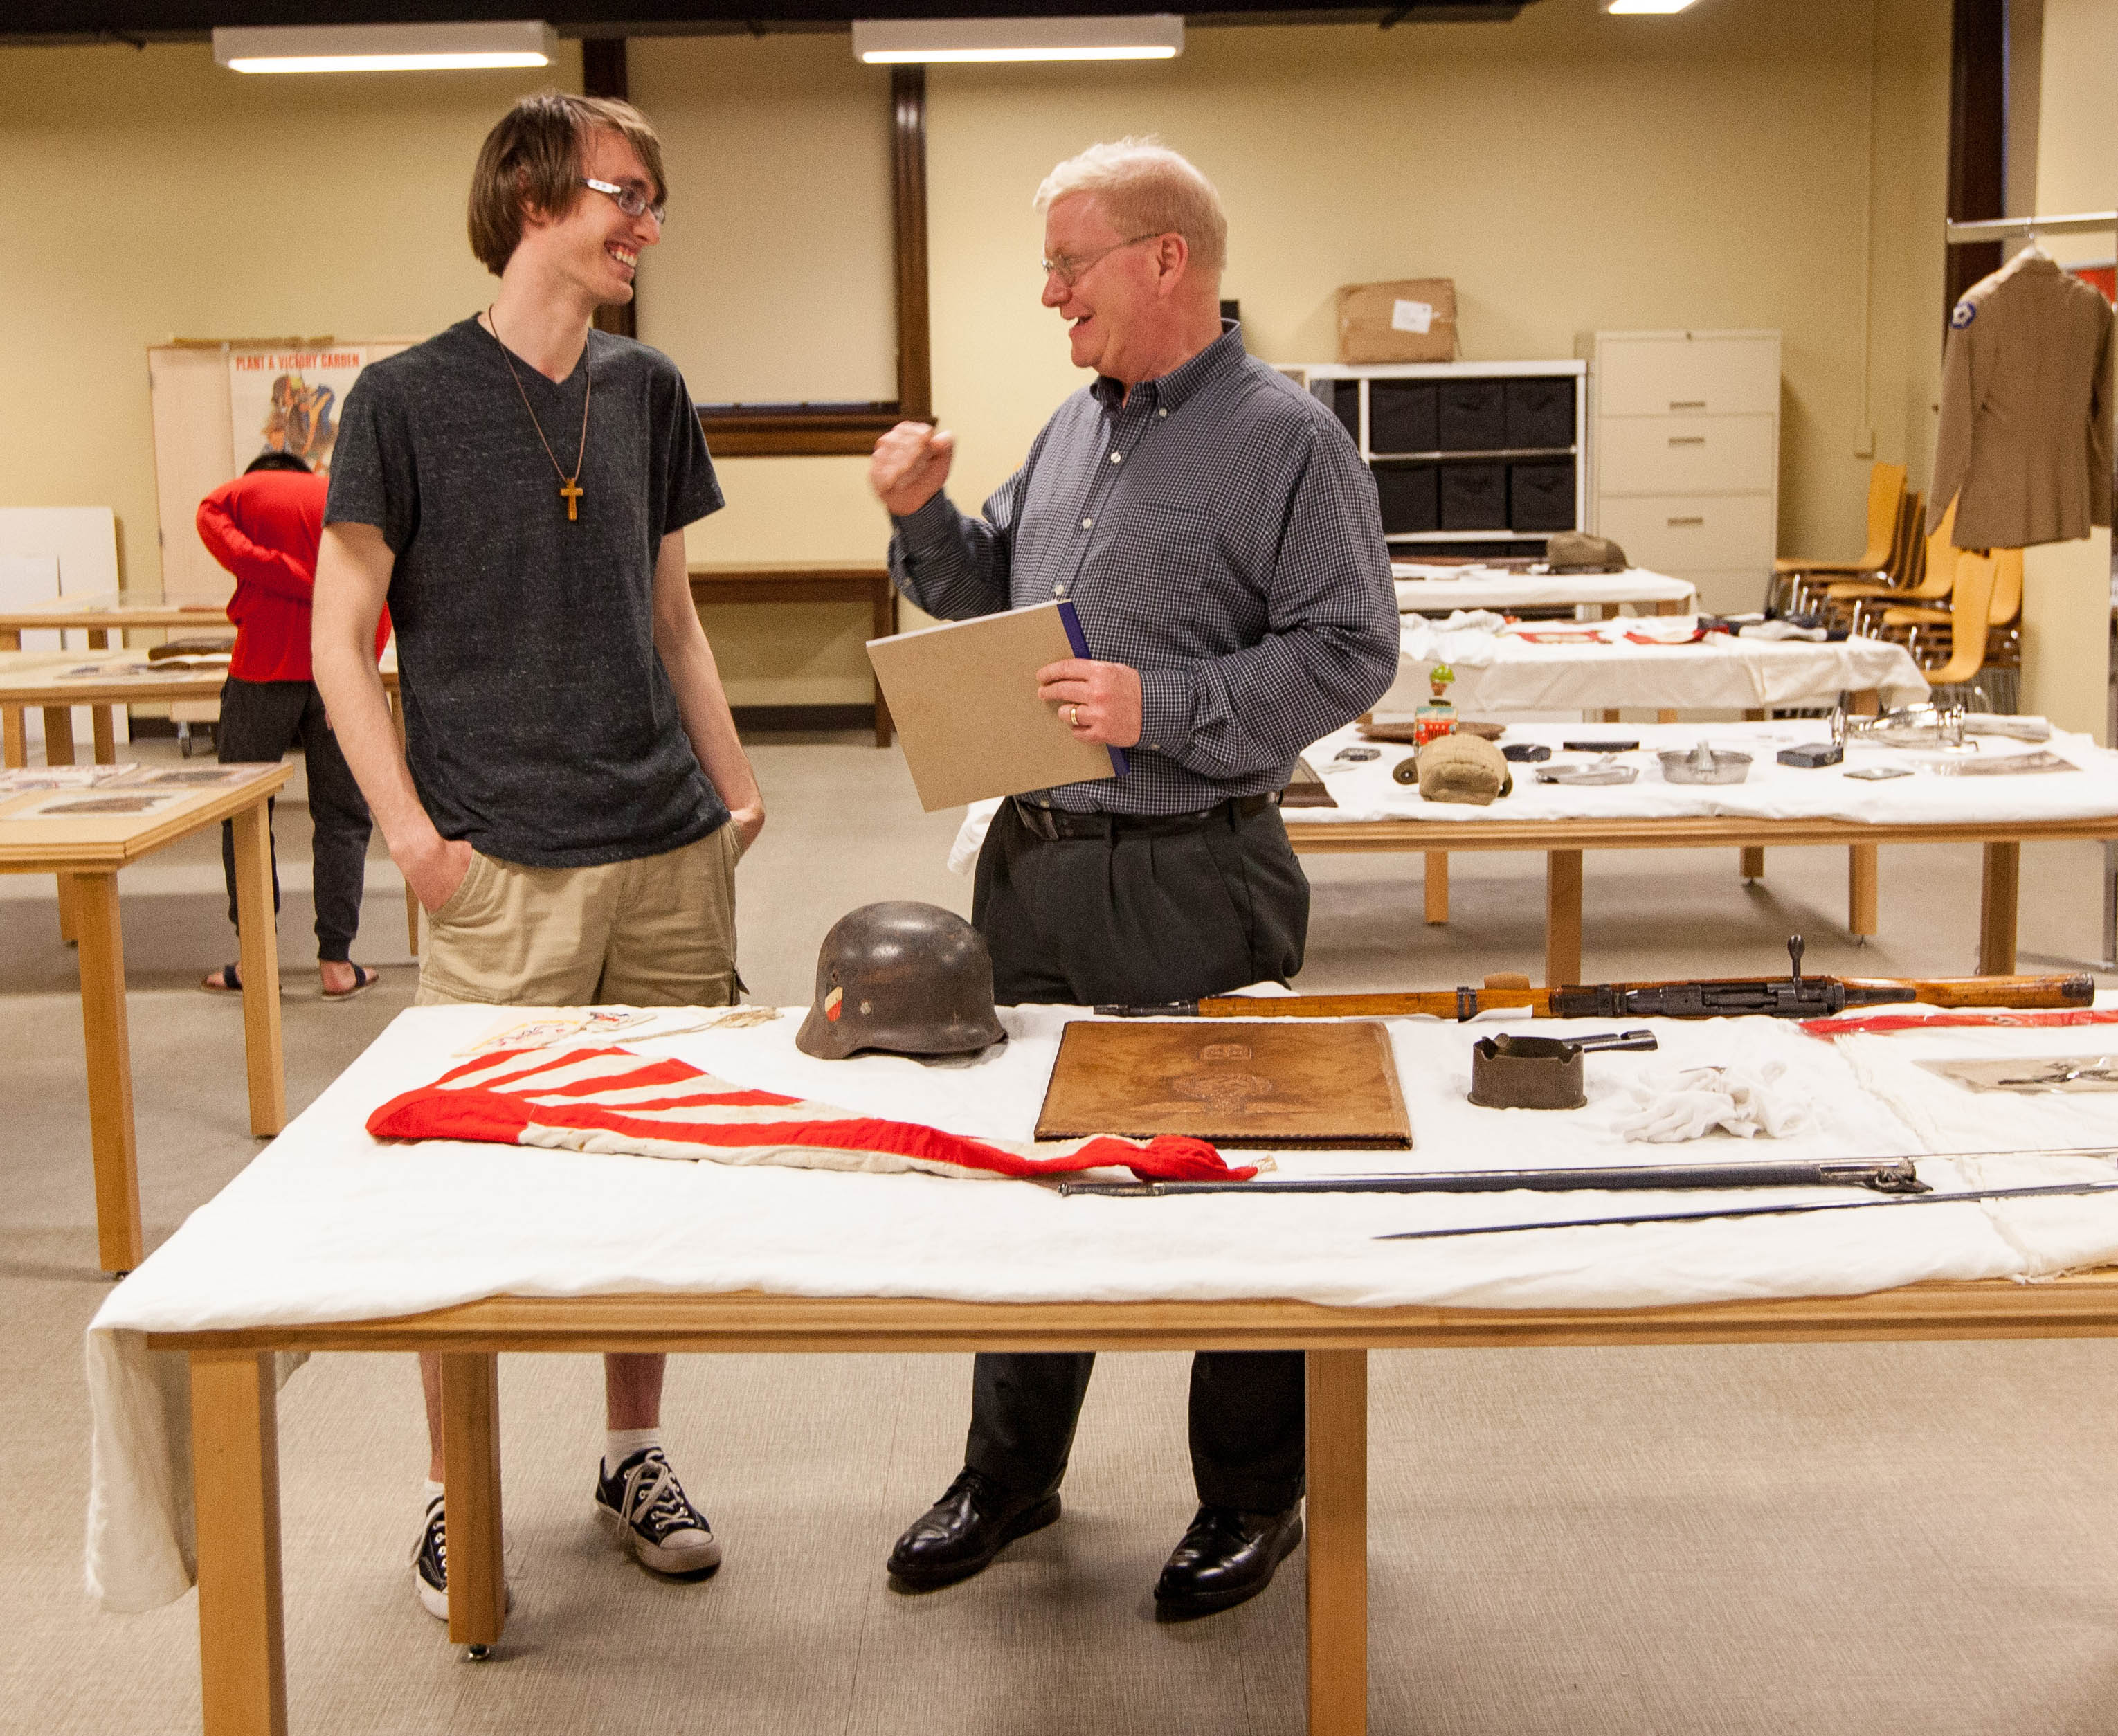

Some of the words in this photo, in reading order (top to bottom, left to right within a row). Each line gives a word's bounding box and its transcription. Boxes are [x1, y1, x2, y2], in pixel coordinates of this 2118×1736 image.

[236, 357, 264, 371] PLANT
[269, 356, 275, 370] A
[279, 354, 318, 369] VICTORY
[321, 354, 360, 368] GARDEN
